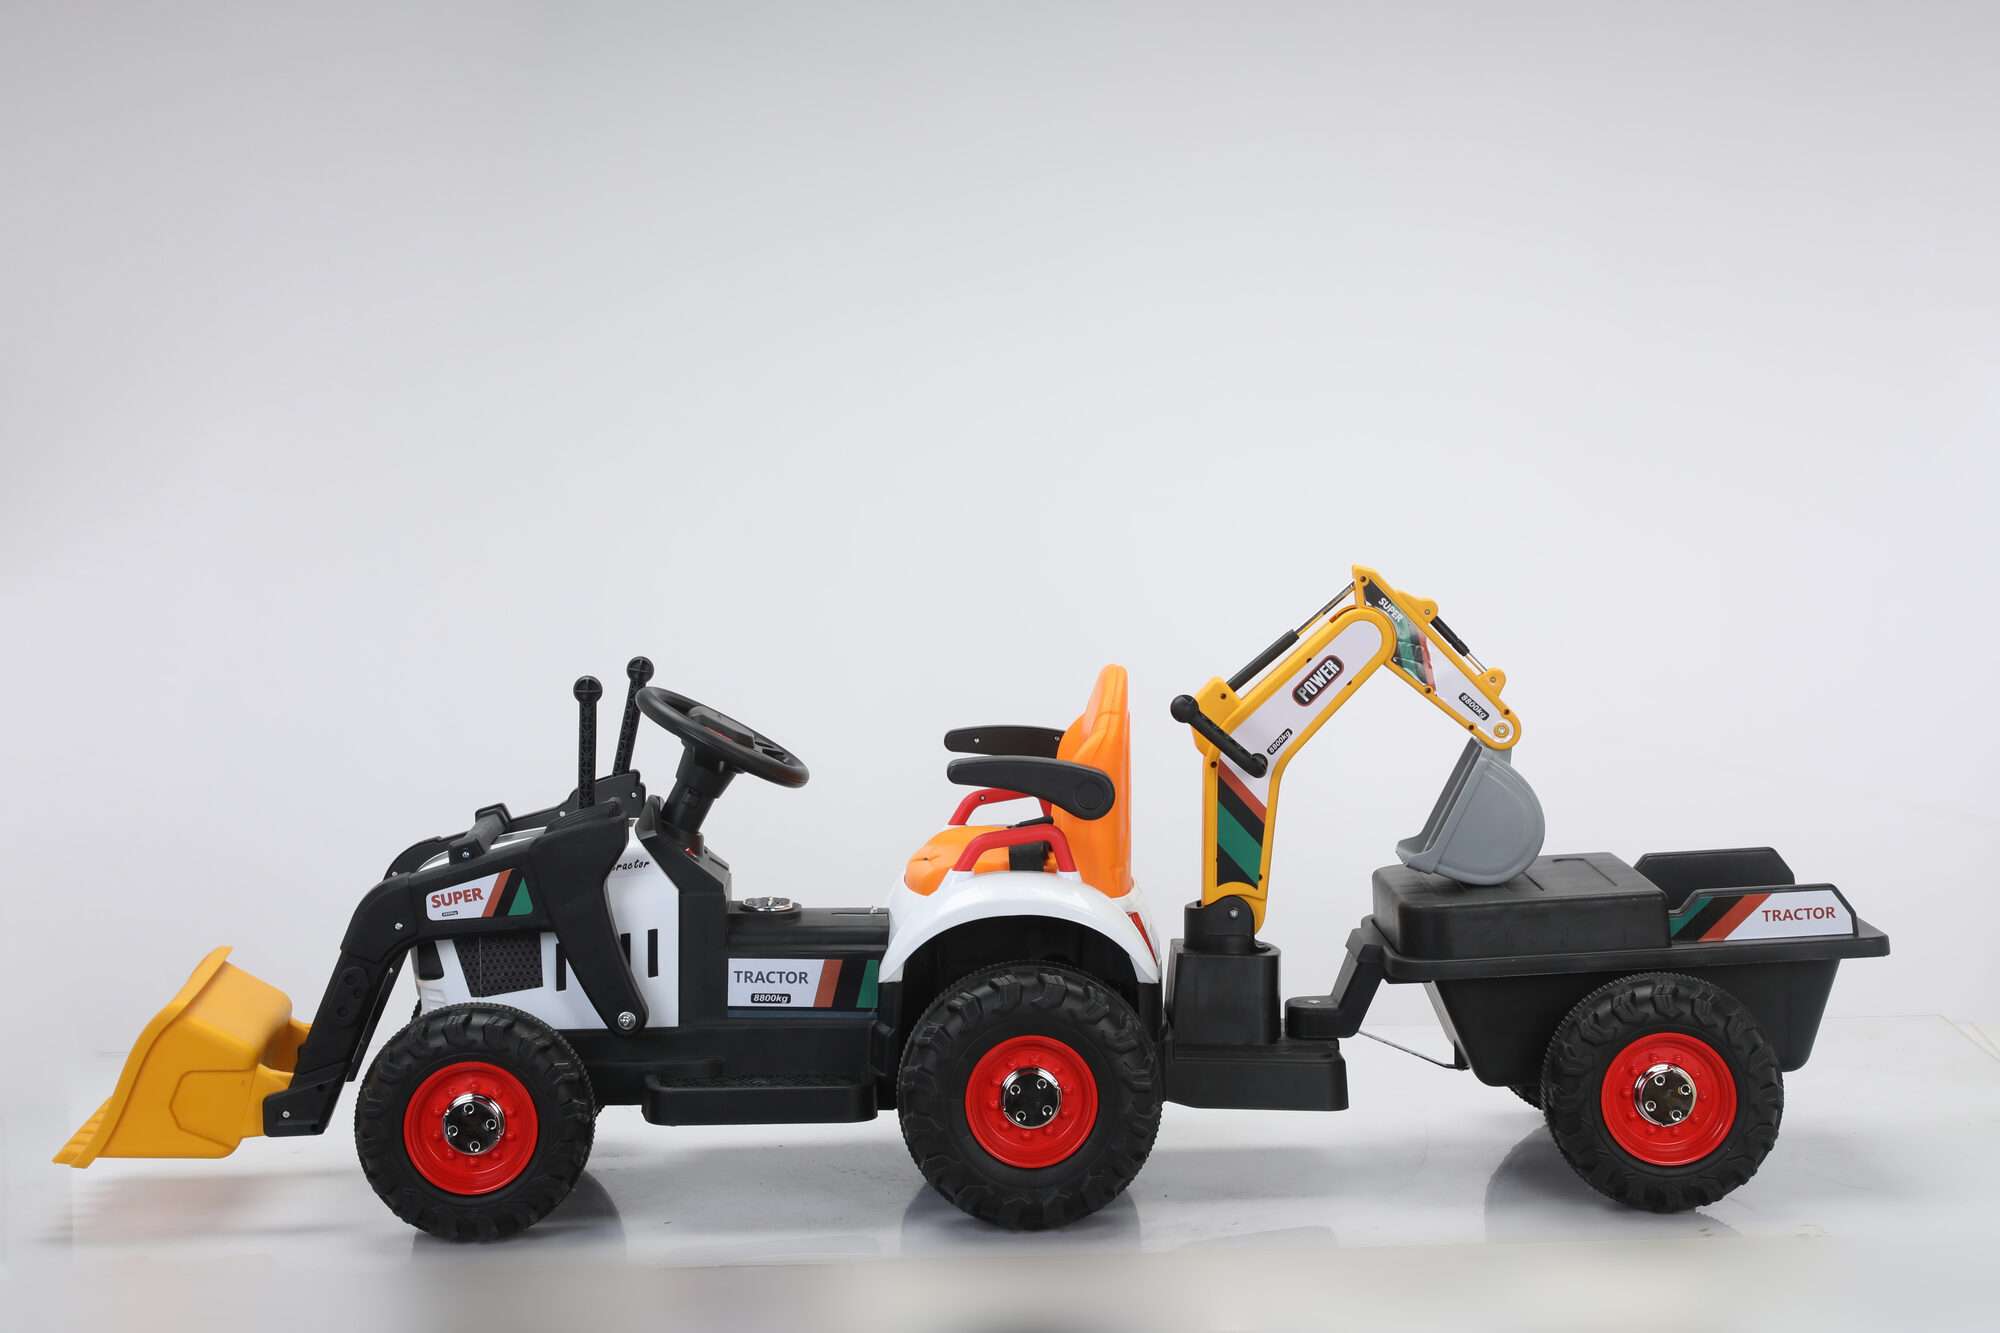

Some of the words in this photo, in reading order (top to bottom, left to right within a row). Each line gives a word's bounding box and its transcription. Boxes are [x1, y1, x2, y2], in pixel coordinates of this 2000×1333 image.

[1378, 597, 1404, 622] SUPER
[1296, 660, 1340, 702] POWER
[1460, 694, 1488, 719] 8800kg
[431, 887, 484, 908] SUPER
[1761, 906, 1837, 922] TRACTOR
[733, 970, 809, 985] TRACTOR
[753, 994, 789, 1004] 8800kg
